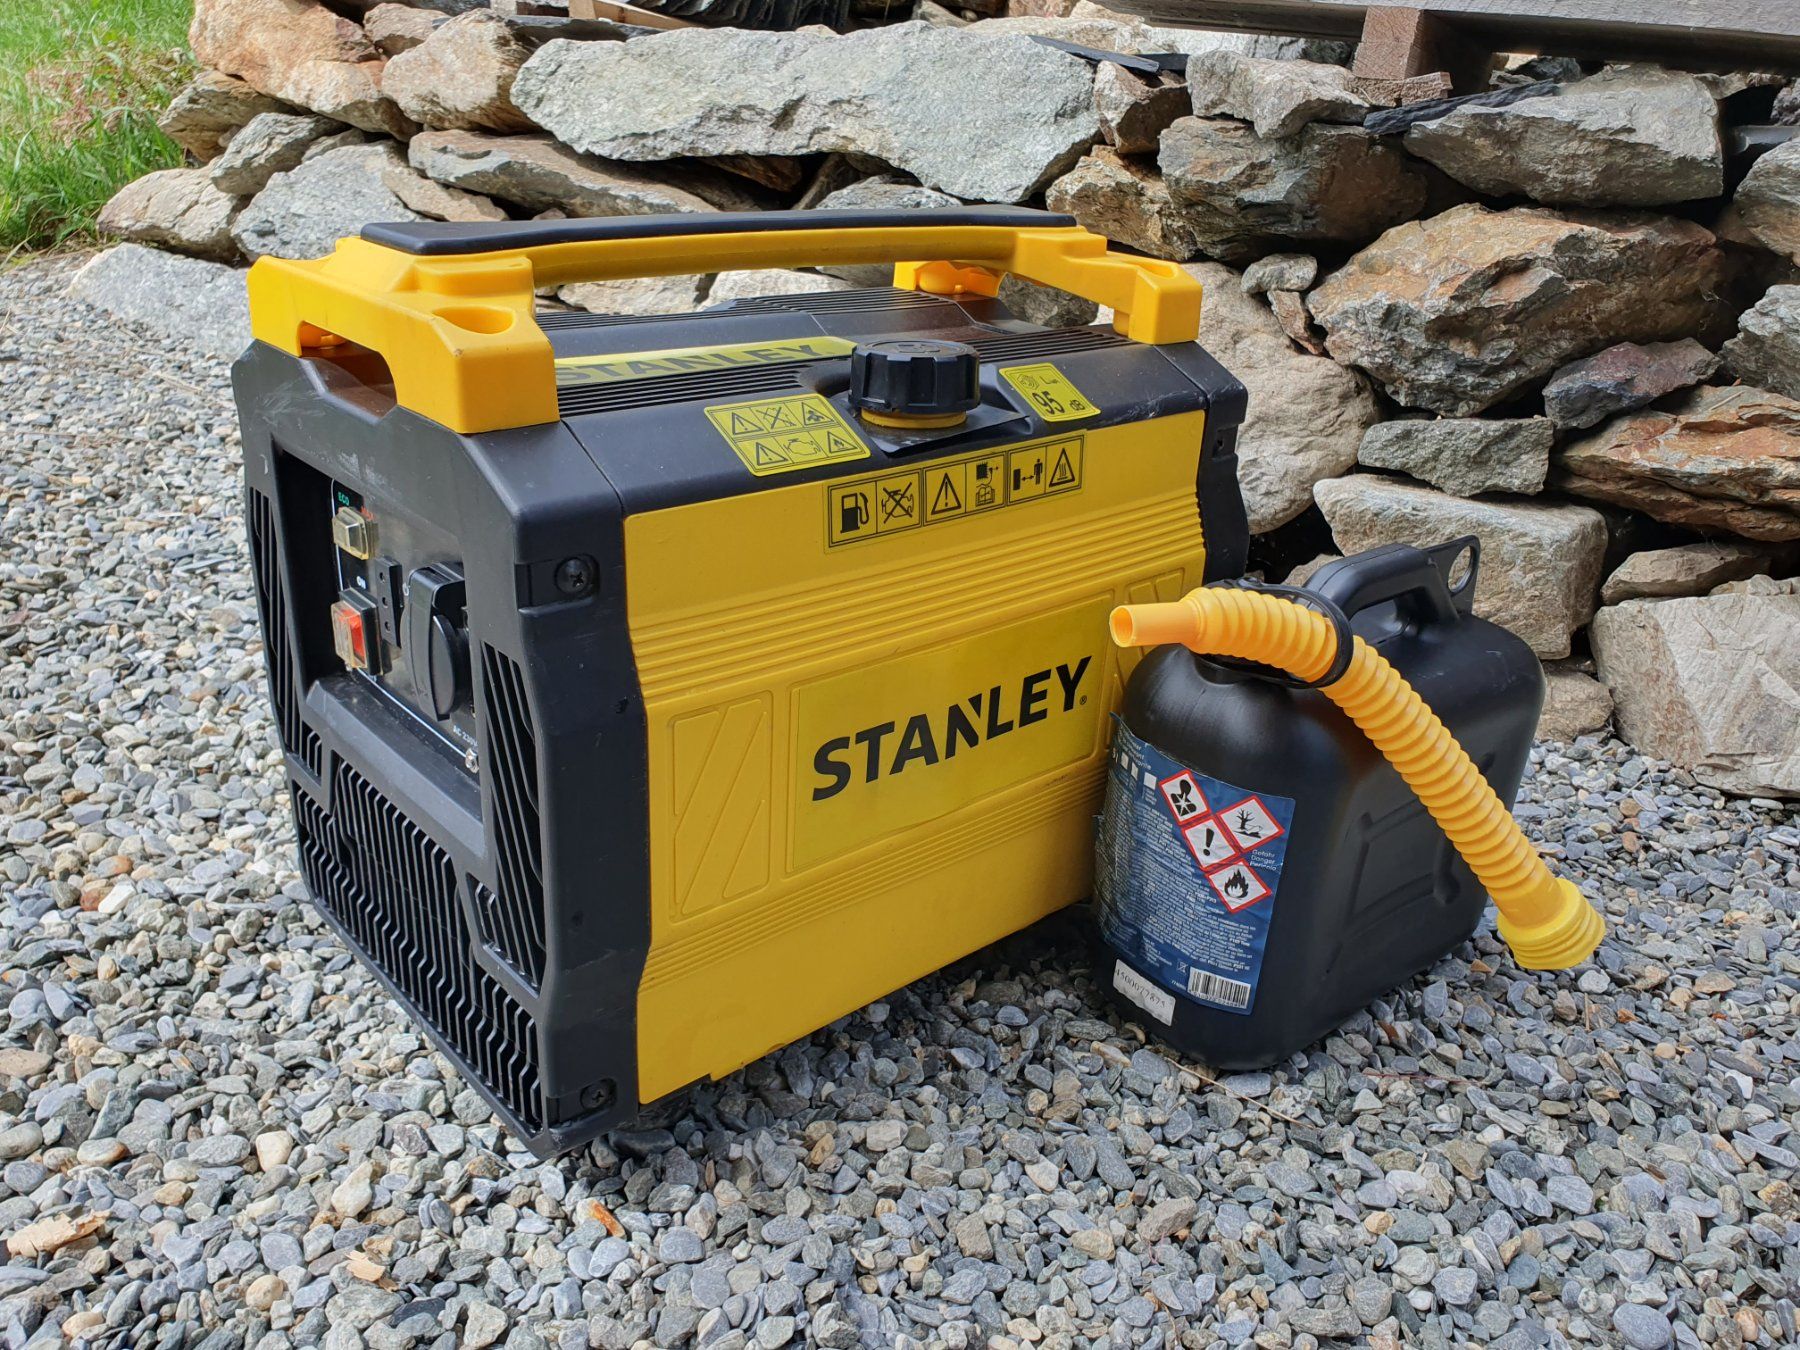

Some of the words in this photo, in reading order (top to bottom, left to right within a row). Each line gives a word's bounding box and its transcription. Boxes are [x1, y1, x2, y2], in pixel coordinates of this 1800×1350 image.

[556, 344, 822, 384] STANLEY
[1032, 391, 1065, 414] 95
[338, 491, 350, 506] ECO
[356, 575, 366, 589] ON
[812, 655, 1092, 801] STANLEY
